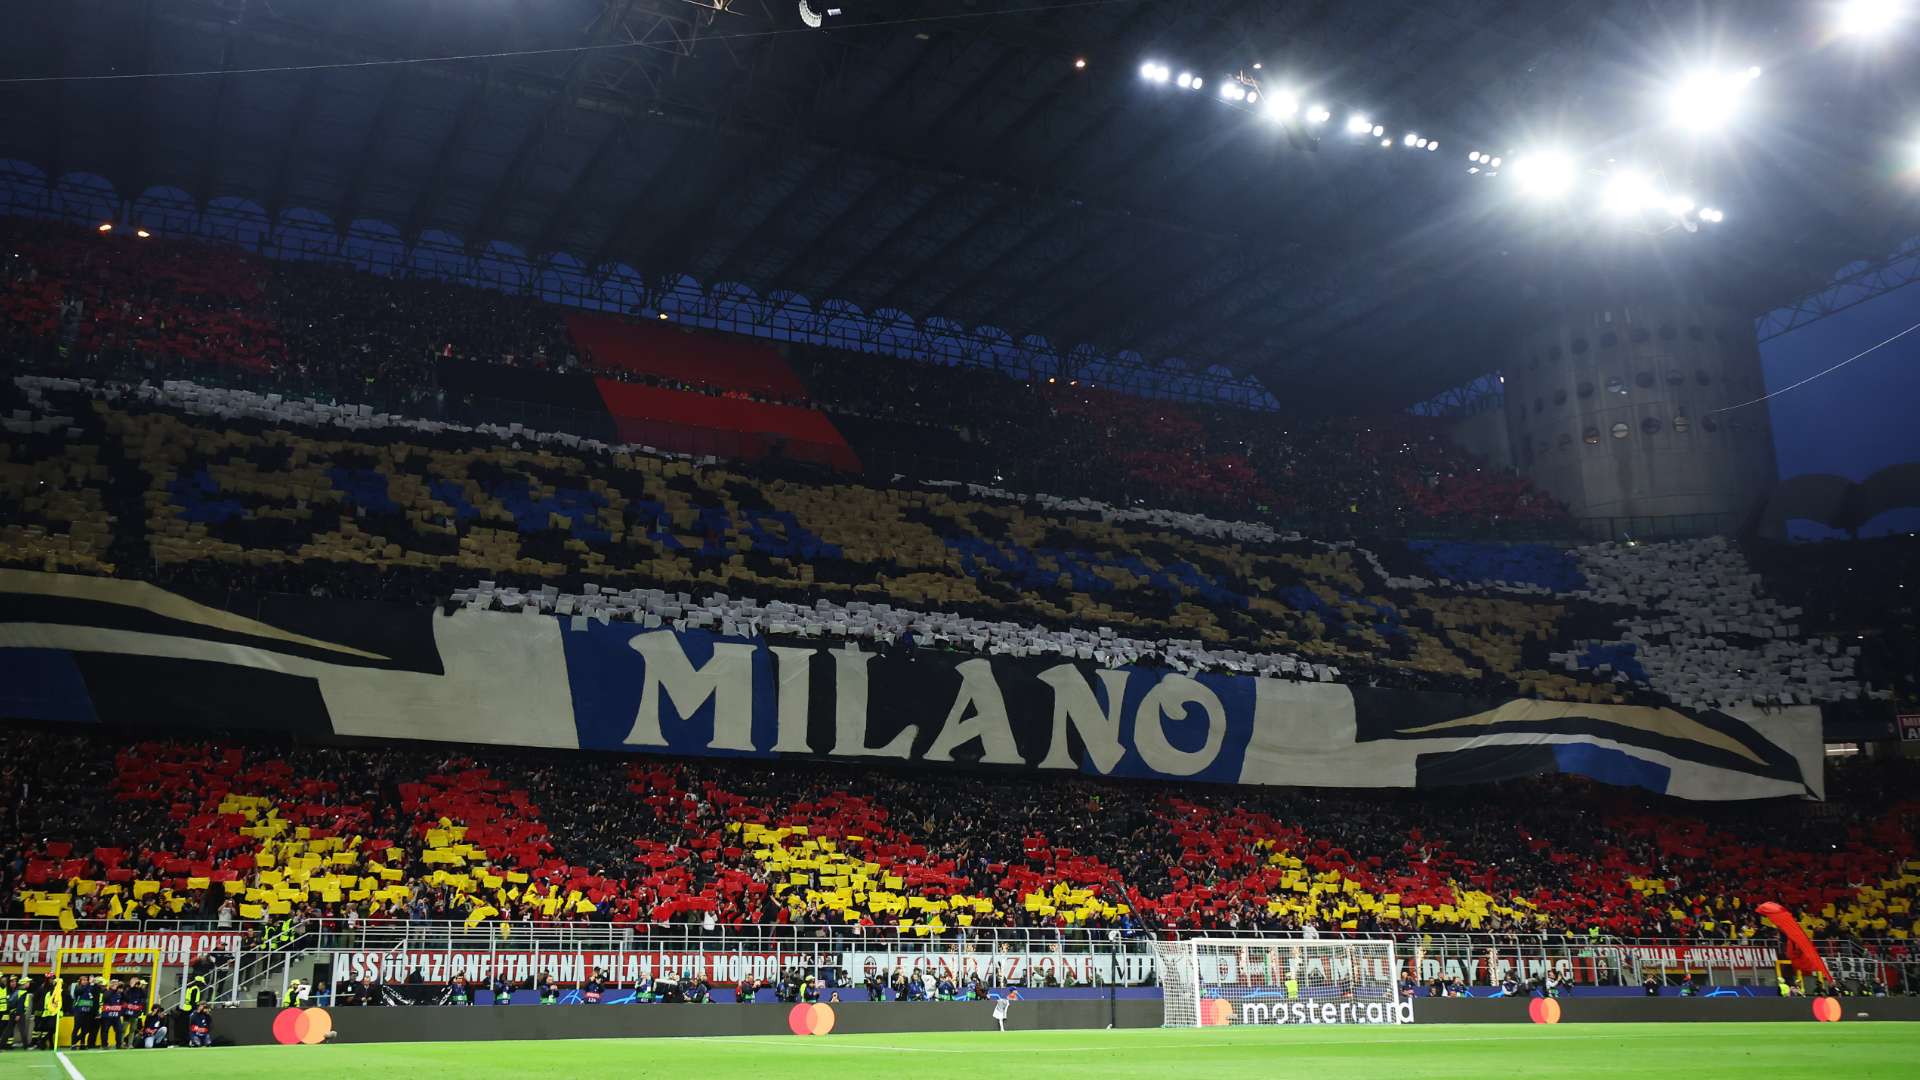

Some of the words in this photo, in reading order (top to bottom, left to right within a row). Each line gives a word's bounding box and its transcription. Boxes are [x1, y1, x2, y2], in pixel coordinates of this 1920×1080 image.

[621, 629, 1227, 776] MILANO
[0, 934, 40, 963] ASA
[46, 935, 107, 963] MILAN
[125, 935, 192, 963] JUNIOR
[713, 955, 777, 983] MONDO
[1421, 958, 1479, 981] DAY
[1243, 997, 1415, 1025] mastercard
